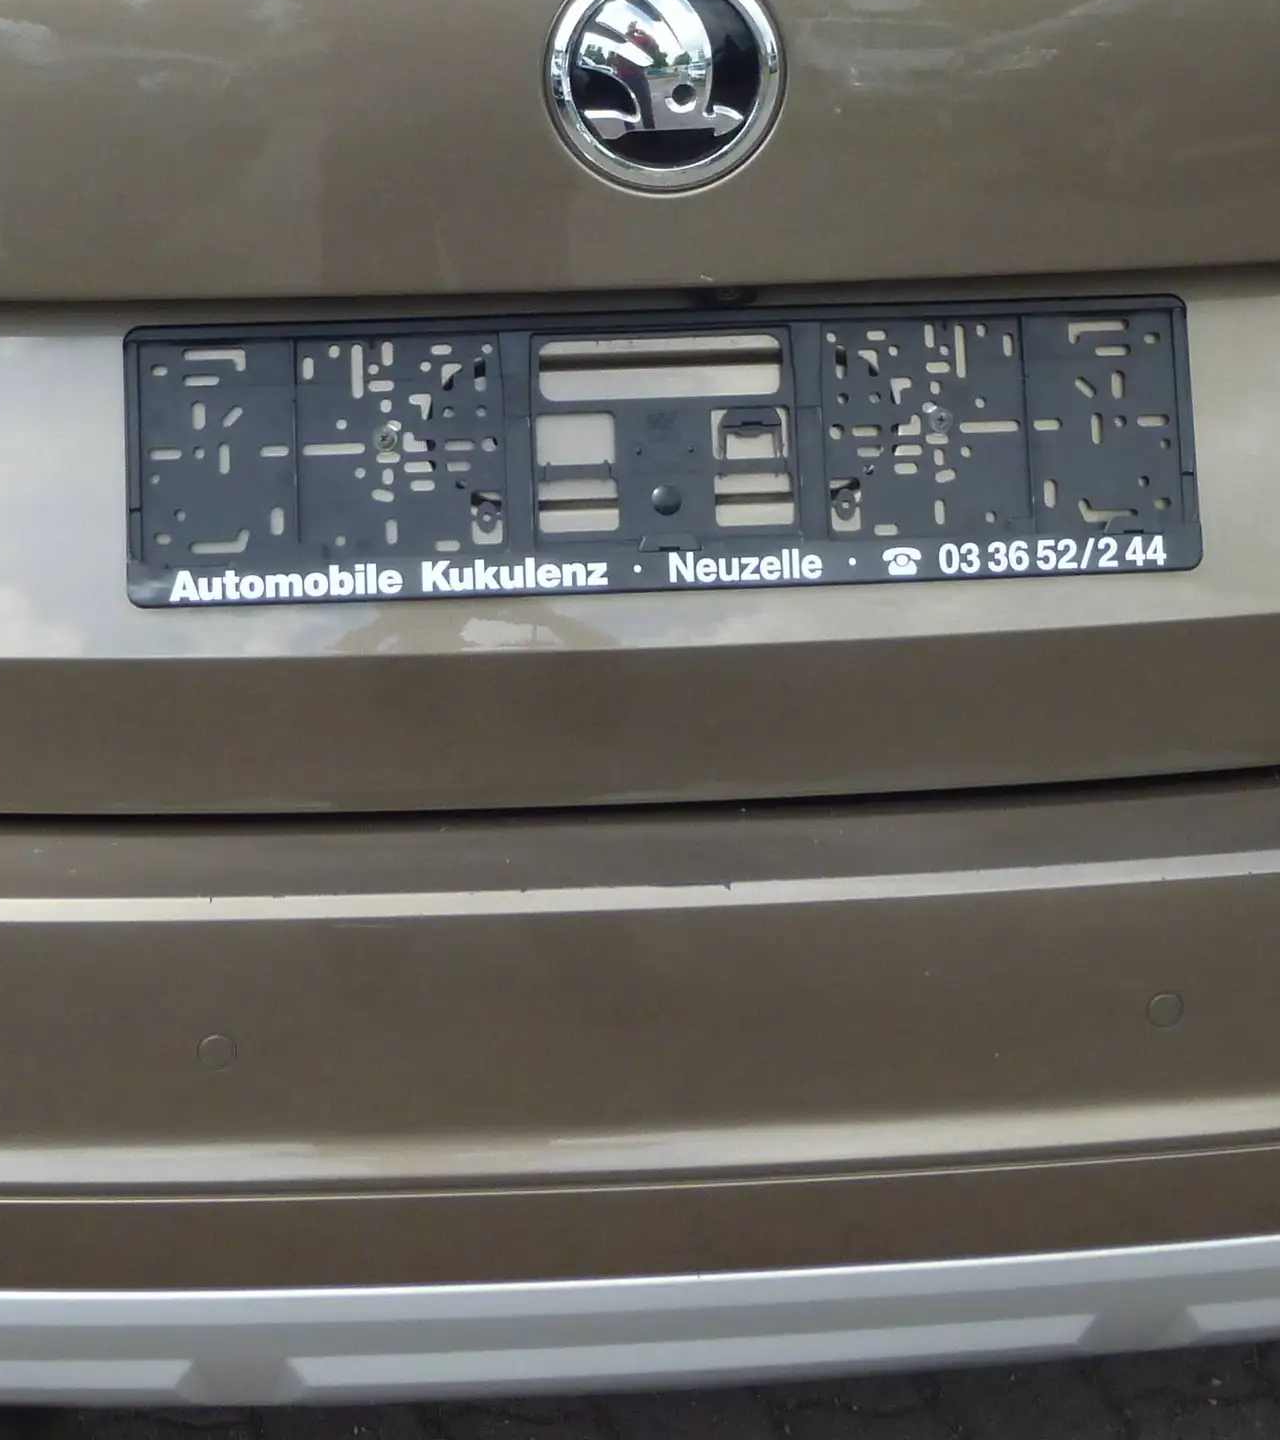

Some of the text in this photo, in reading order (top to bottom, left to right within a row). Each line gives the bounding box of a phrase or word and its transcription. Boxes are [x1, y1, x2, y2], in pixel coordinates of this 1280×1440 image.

[169, 563, 404, 603] Automobile
[422, 557, 609, 593] Kukulenz
[668, 548, 823, 583] Neuzelle
[938, 542, 981, 575] 03
